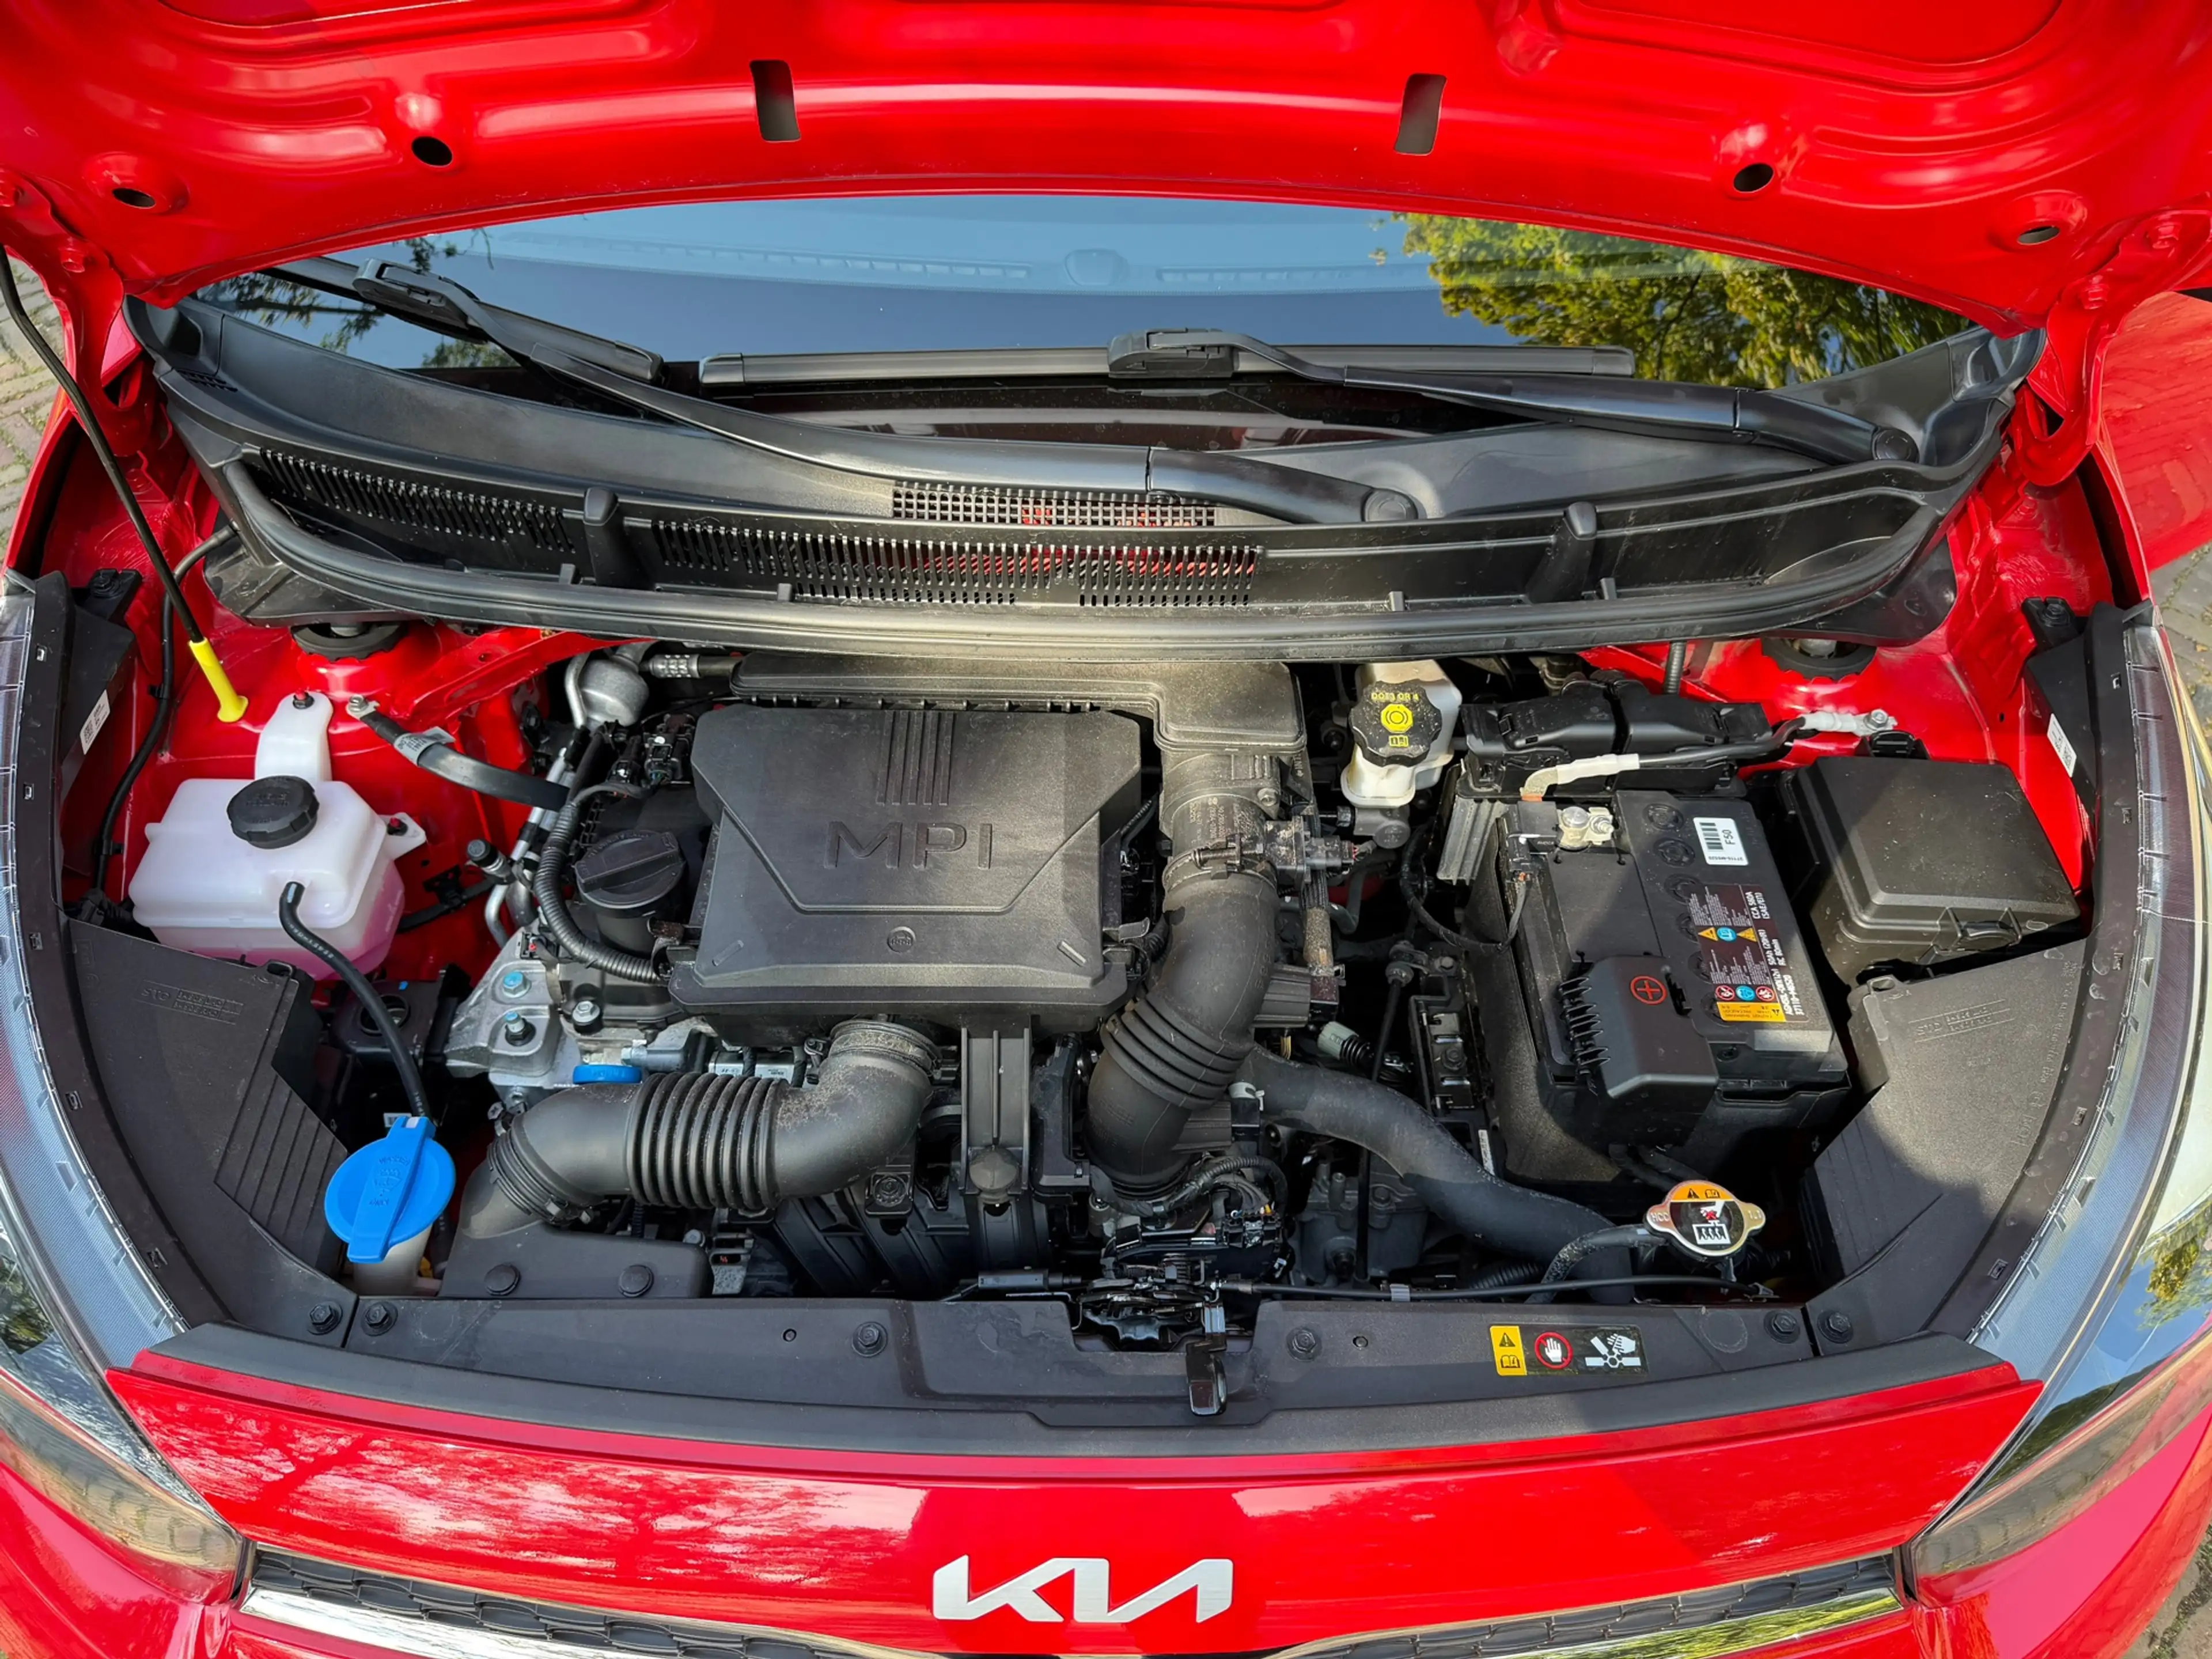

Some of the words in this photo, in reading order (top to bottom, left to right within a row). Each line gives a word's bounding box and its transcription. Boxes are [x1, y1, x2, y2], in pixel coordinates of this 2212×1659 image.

[1397, 692, 1411, 702] OR
[824, 820, 993, 869] MPI
[1722, 830, 1736, 845] F50
[1751, 907, 1760, 919] CCA
[933, 1555, 1233, 1623] KIA
